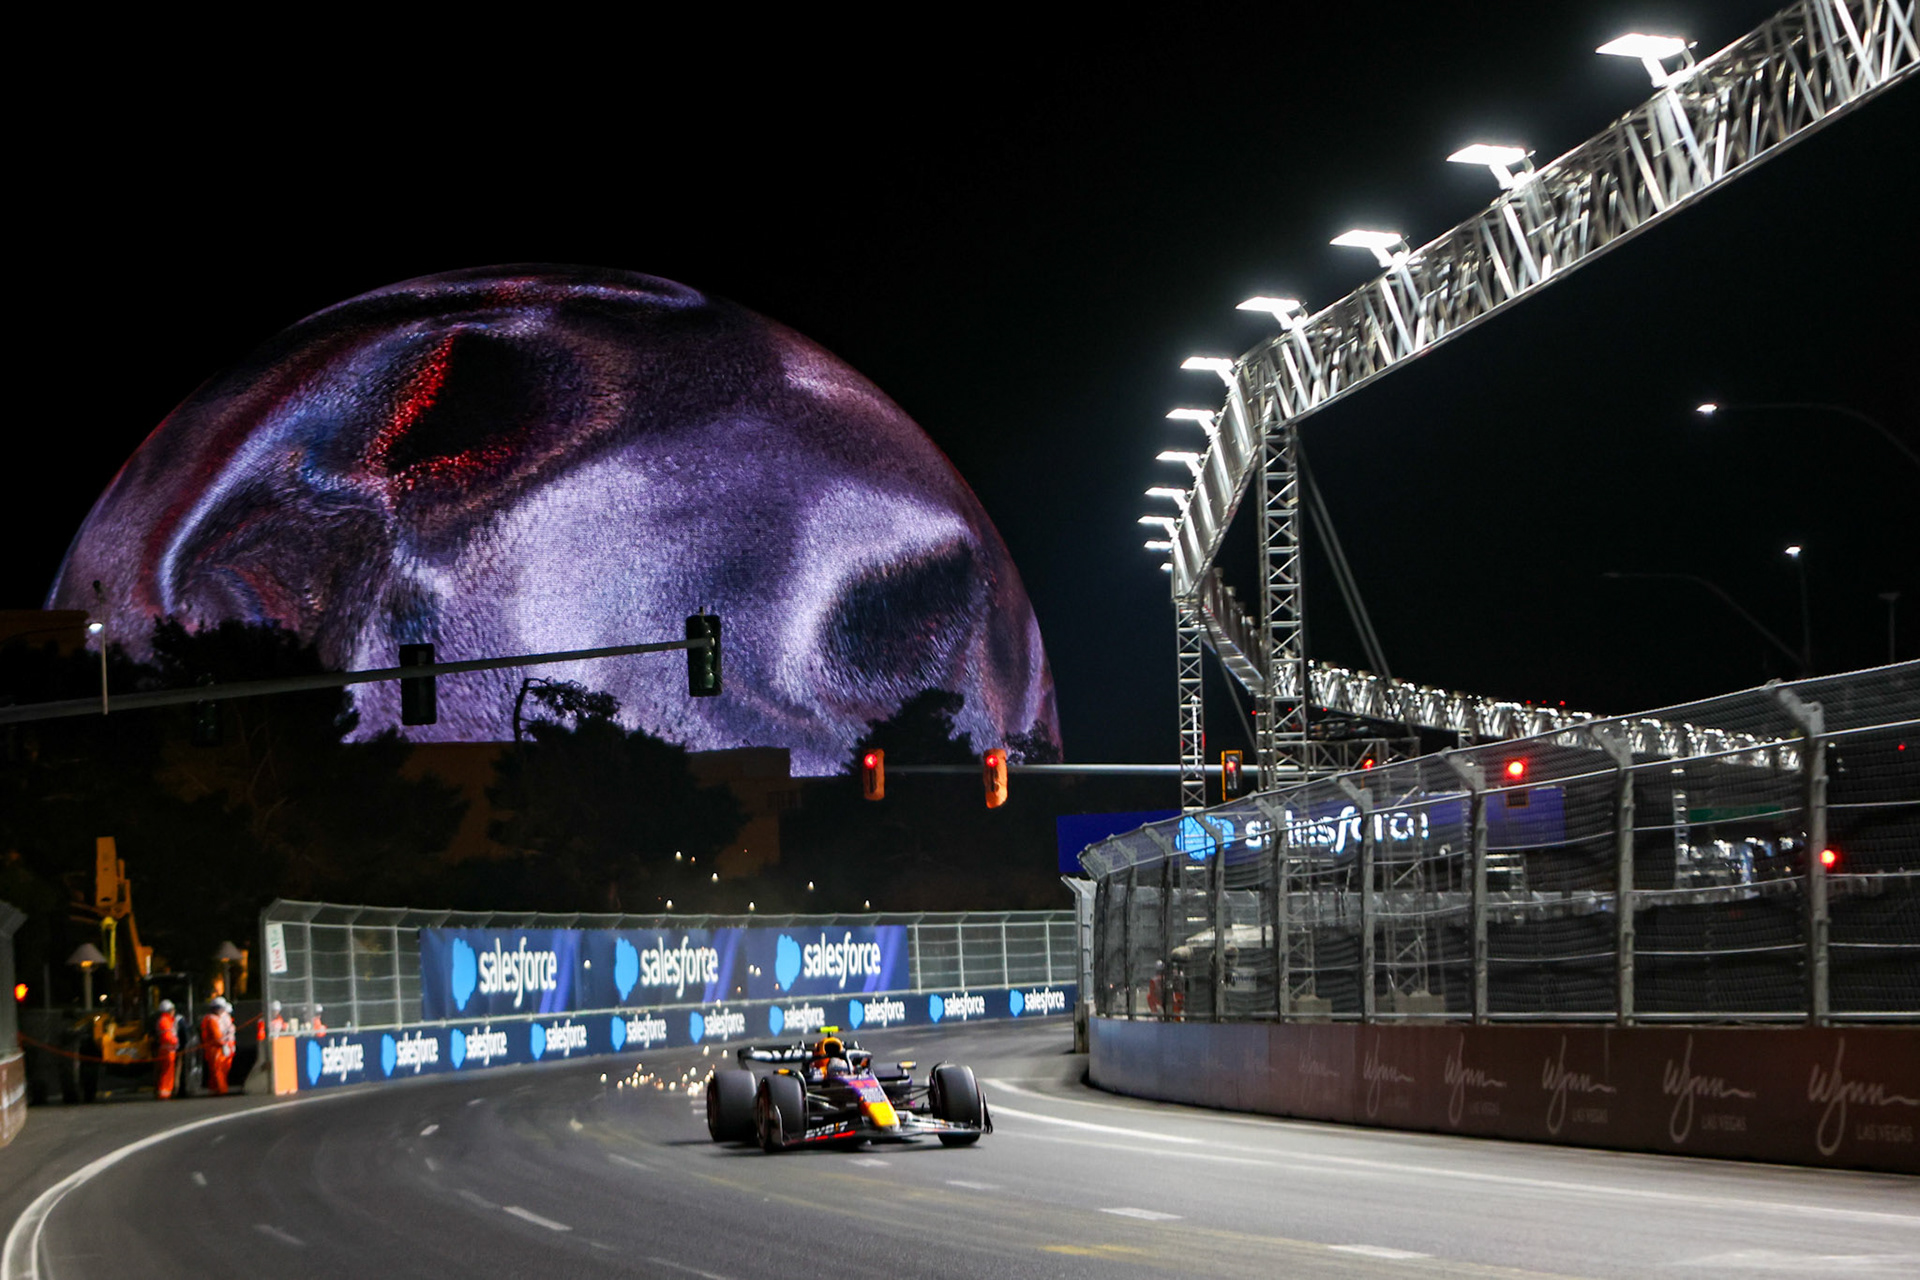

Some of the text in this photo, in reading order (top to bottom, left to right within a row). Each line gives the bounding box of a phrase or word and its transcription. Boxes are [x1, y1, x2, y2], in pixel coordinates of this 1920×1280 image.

[1245, 805, 1429, 854] slesforc
[478, 936, 557, 1008] salesforce
[640, 936, 719, 998] salesforce
[803, 931, 881, 988] salesforce
[704, 1003, 745, 1040] salesforce
[783, 1002, 825, 1033] salesforce
[864, 997, 905, 1026] salesforce
[944, 991, 985, 1020] salesforce
[1024, 987, 1065, 1015] salesforce
[465, 1026, 507, 1065] salesforce
[545, 1019, 587, 1056] salesforce
[626, 1010, 667, 1048] salesforce
[321, 1037, 363, 1081] salesforce
[396, 1031, 438, 1073] salesforce
[1363, 1032, 1415, 1118] Wynn
[1444, 1033, 1507, 1126] Wynn
[1542, 1034, 1616, 1135] Wynn
[1663, 1034, 1756, 1143] Wynn
[1808, 1037, 1920, 1155] Wynn
